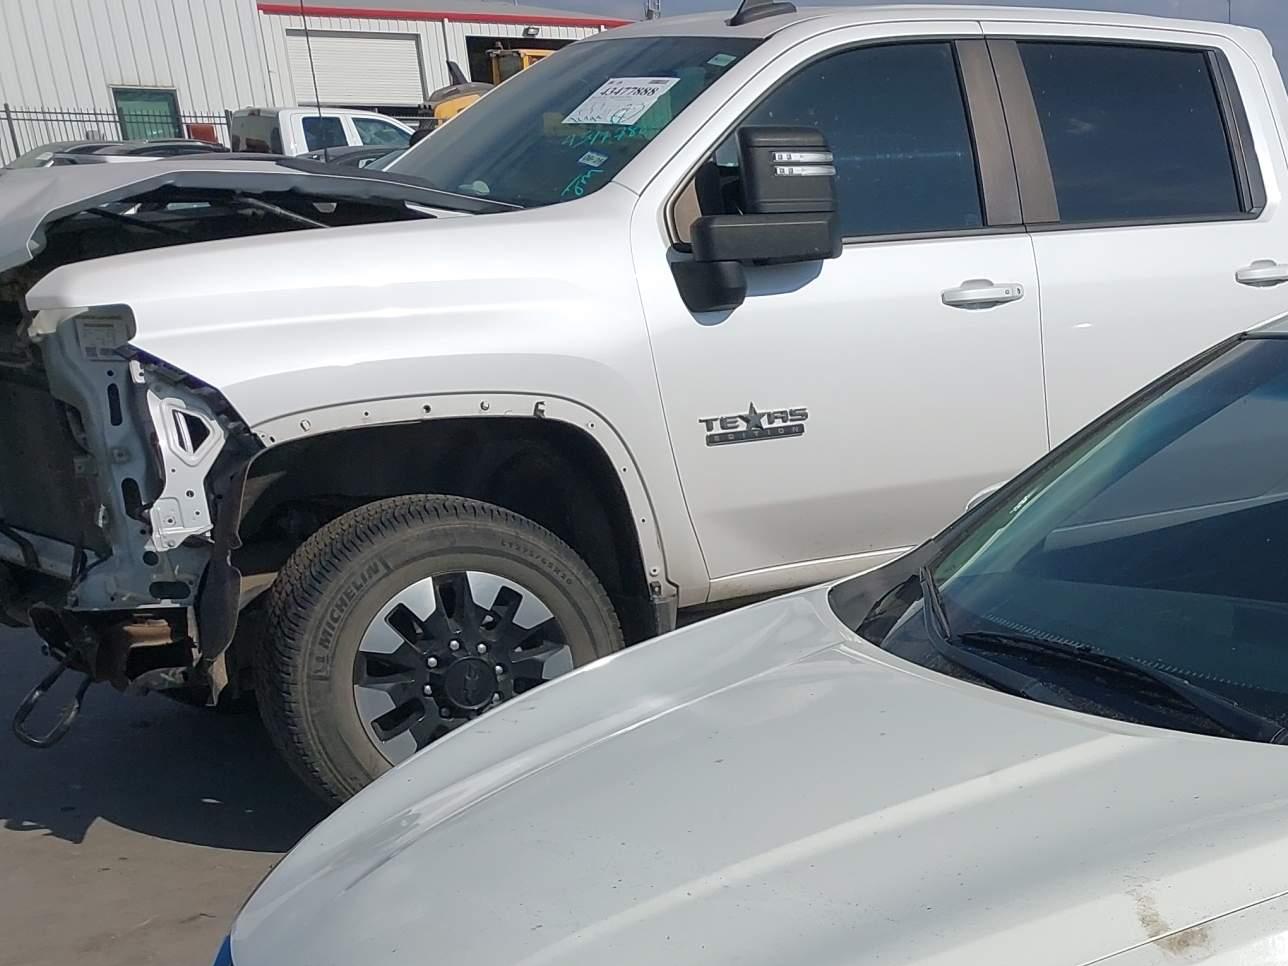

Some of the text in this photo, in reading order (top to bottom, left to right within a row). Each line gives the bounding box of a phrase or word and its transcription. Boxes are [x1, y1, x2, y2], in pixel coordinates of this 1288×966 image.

[599, 86, 659, 97] 43477888
[698, 401, 809, 432] TEXAS
[710, 426, 802, 443] EDITION
[318, 561, 384, 650] MICHELIN
